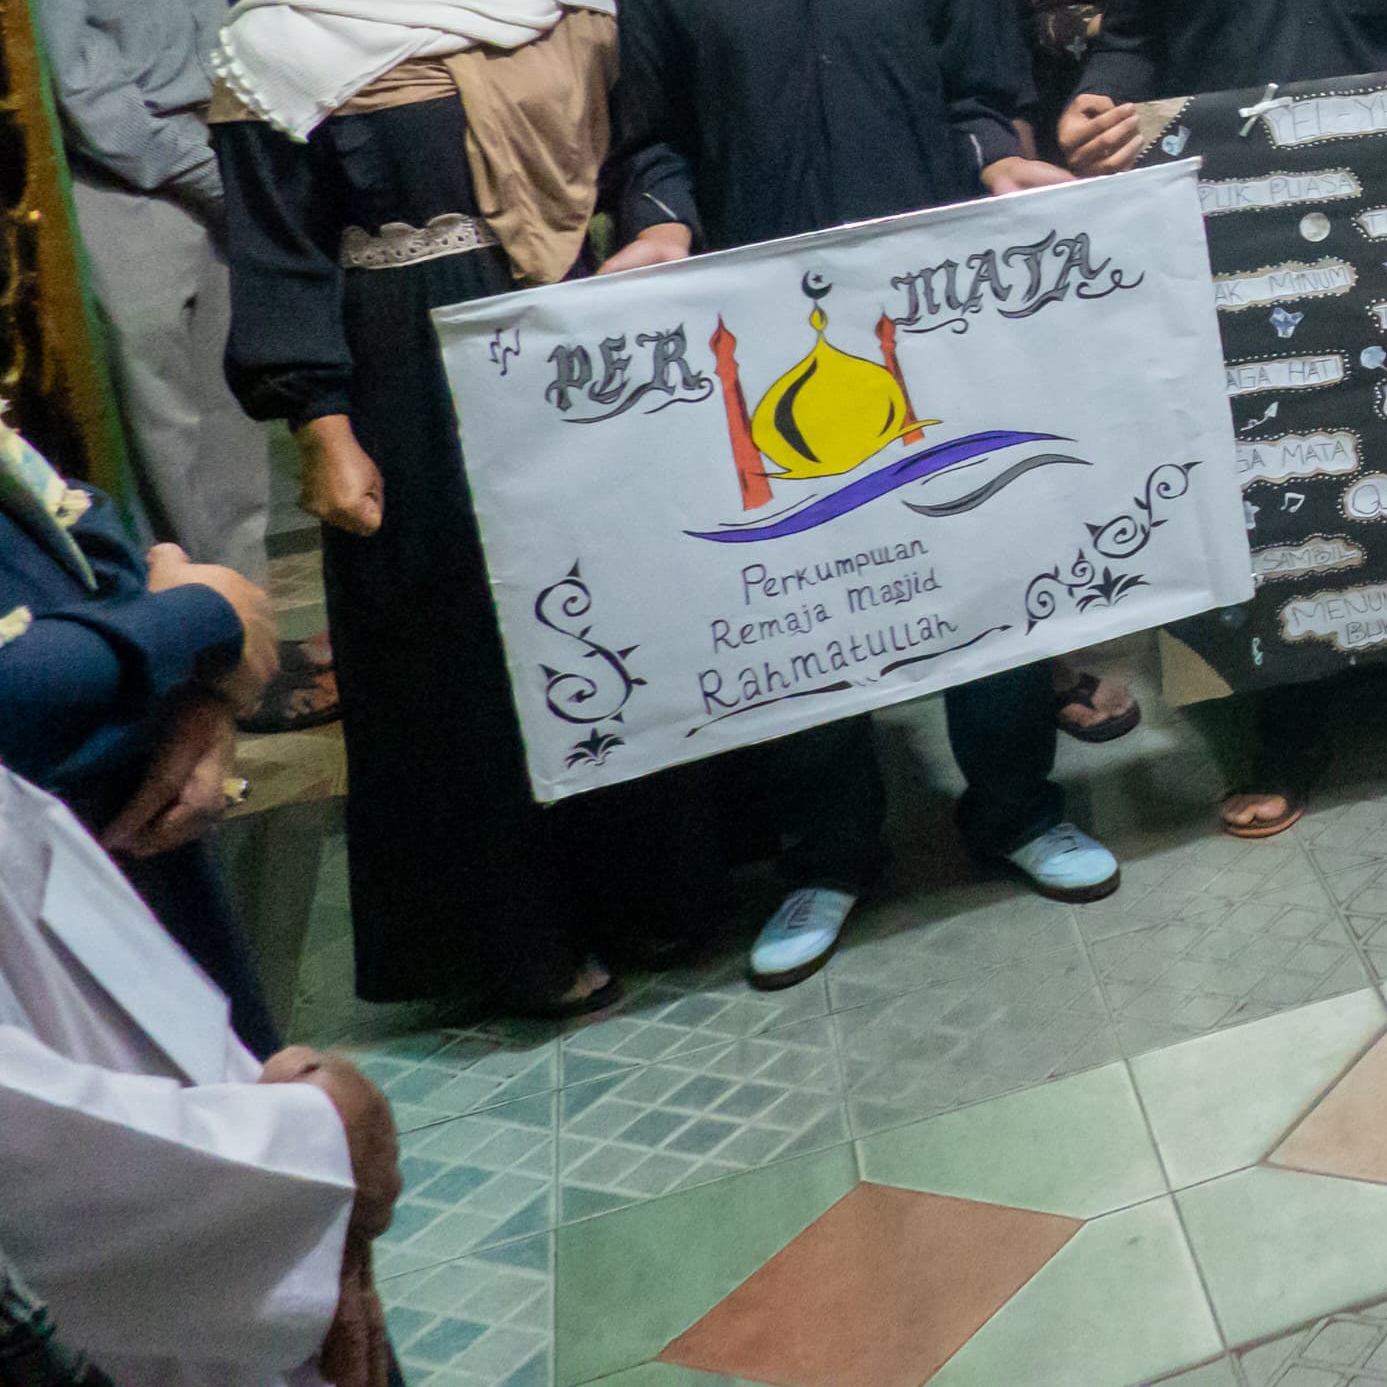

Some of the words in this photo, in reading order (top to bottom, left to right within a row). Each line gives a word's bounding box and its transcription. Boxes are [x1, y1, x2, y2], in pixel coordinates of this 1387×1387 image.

[1270, 172, 1353, 202] PUASA
[1269, 266, 1349, 295] MINUM
[1289, 357, 1341, 385] HATI
[1282, 439, 1348, 467] MATA
[740, 538, 929, 606] Perkumpulan
[1262, 545, 1356, 571] SAMBIL
[710, 602, 832, 655] Remaja
[697, 614, 959, 715] Rahmatullah
